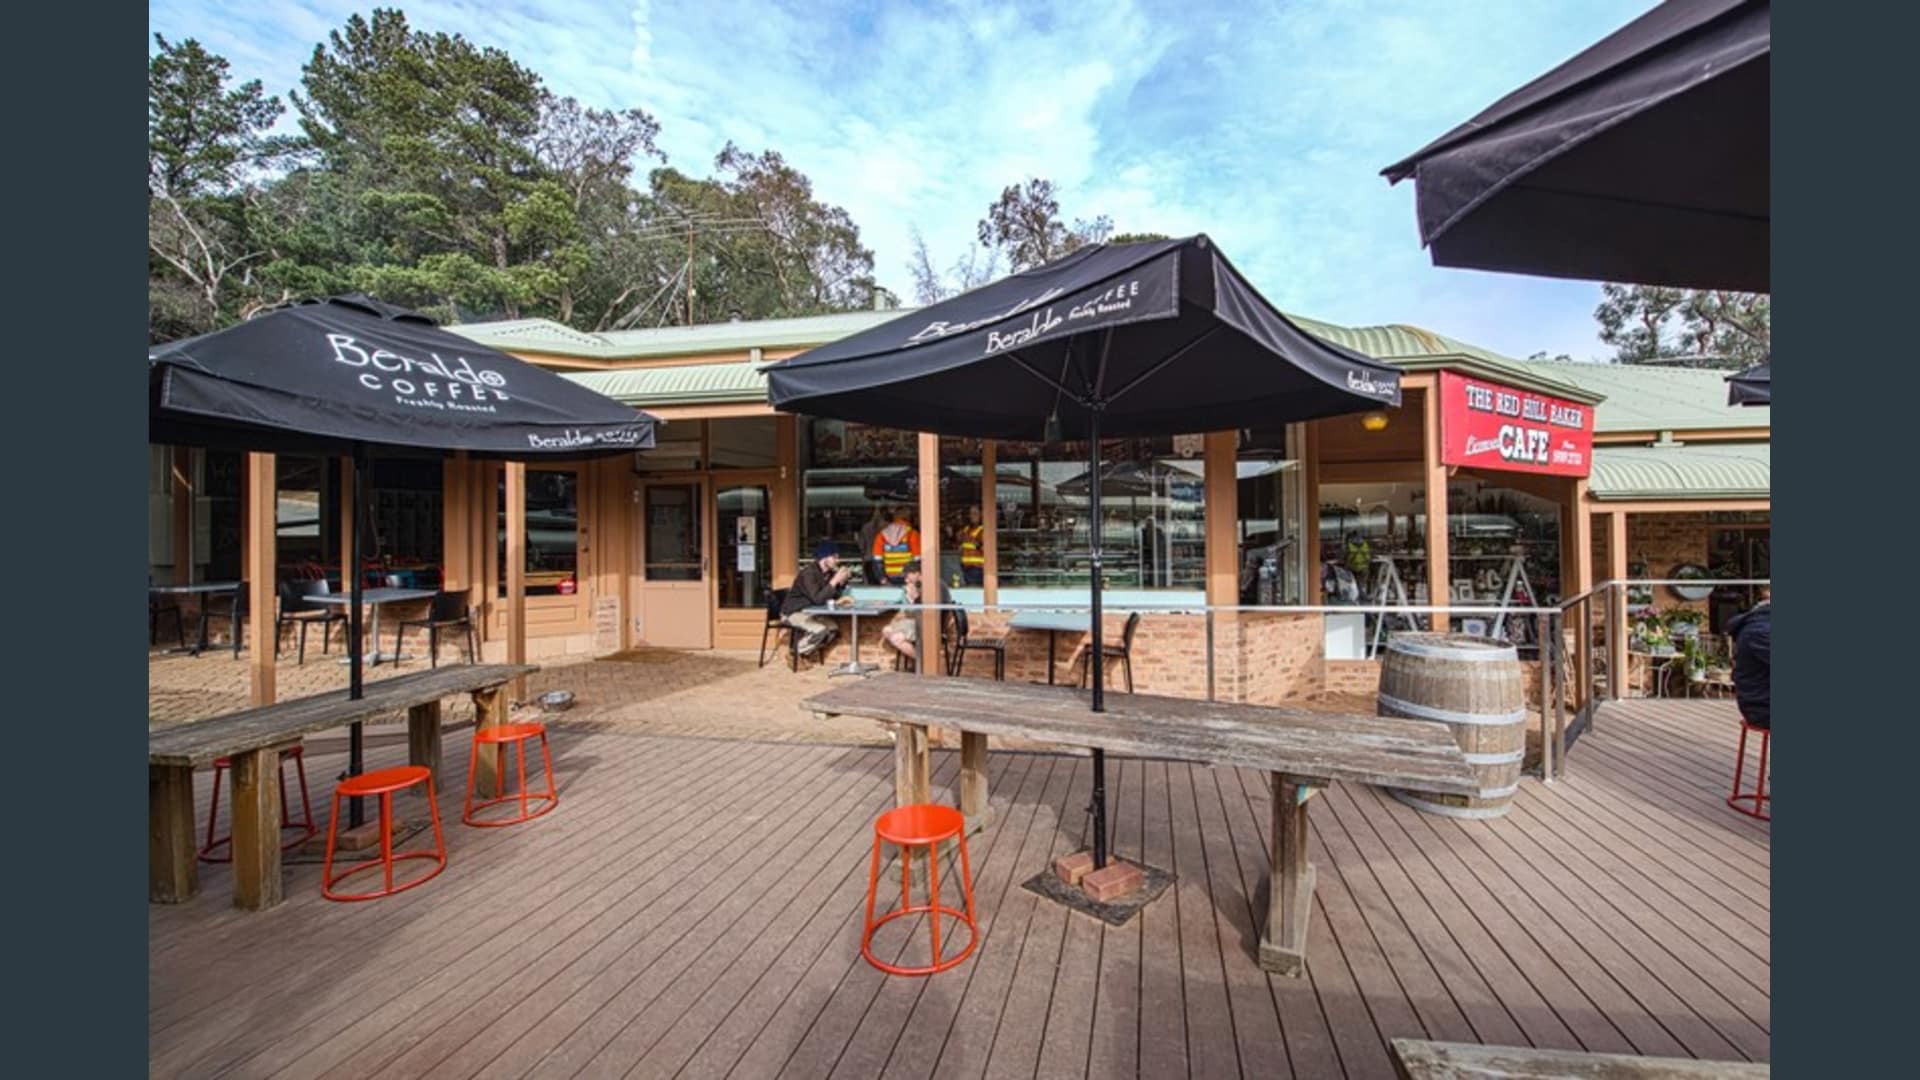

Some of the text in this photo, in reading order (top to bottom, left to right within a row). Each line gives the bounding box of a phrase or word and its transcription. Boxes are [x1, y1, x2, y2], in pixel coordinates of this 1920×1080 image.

[985, 308, 1063, 354] Beraldo
[326, 333, 506, 387] Beraldo
[1465, 385, 1493, 411] THE
[1496, 392, 1520, 417] RED
[1523, 398, 1548, 422] HILL
[1499, 424, 1549, 465] CAFE
